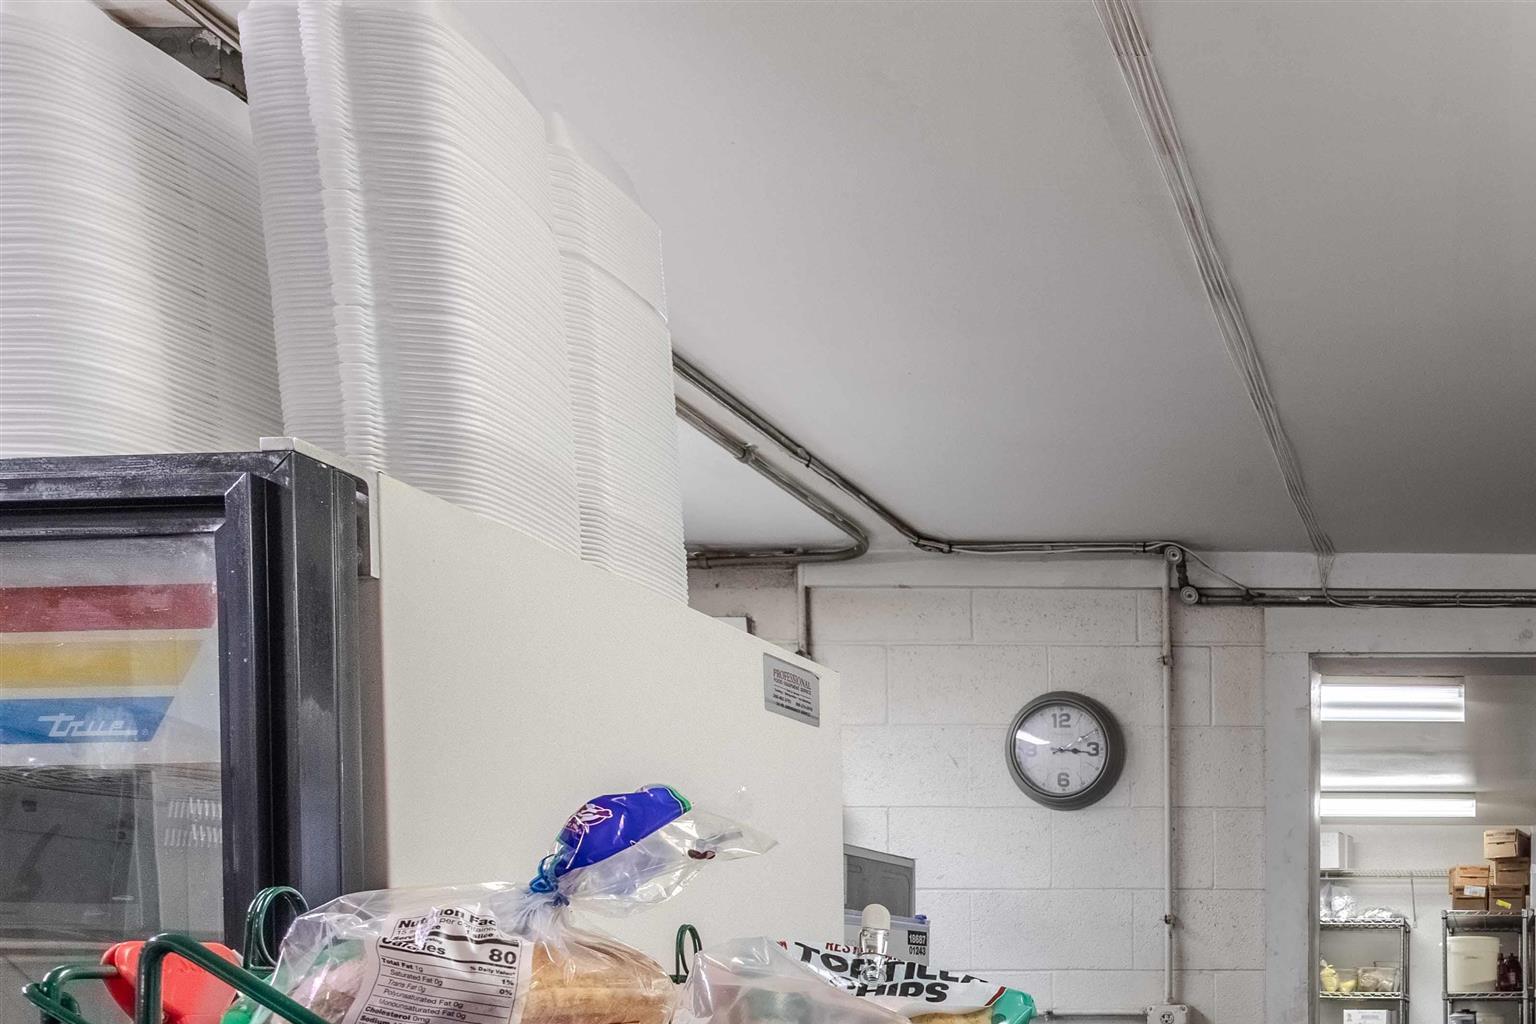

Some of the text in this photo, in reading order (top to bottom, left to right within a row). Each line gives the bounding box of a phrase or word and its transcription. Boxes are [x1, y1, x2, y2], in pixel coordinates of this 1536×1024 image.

[38, 712, 138, 738] true
[1052, 713, 1071, 728] 12
[1087, 741, 1099, 757] 3
[1057, 772, 1069, 787] 6
[488, 948, 517, 965] 80
[909, 947, 926, 955] 01243
[381, 957, 400, 967] Total
[415, 965, 424, 973] 1g
[390, 968, 443, 986] Saturated Fat 0g
[388, 979, 426, 993] Trans Fat 0g
[499, 988, 512, 996] 0%
[842, 976, 949, 1003] HIPS
[453, 1002, 464, 1010] 0g
[365, 1006, 431, 1024] Cholesterol 0mg
[456, 1012, 467, 1020] 0g
